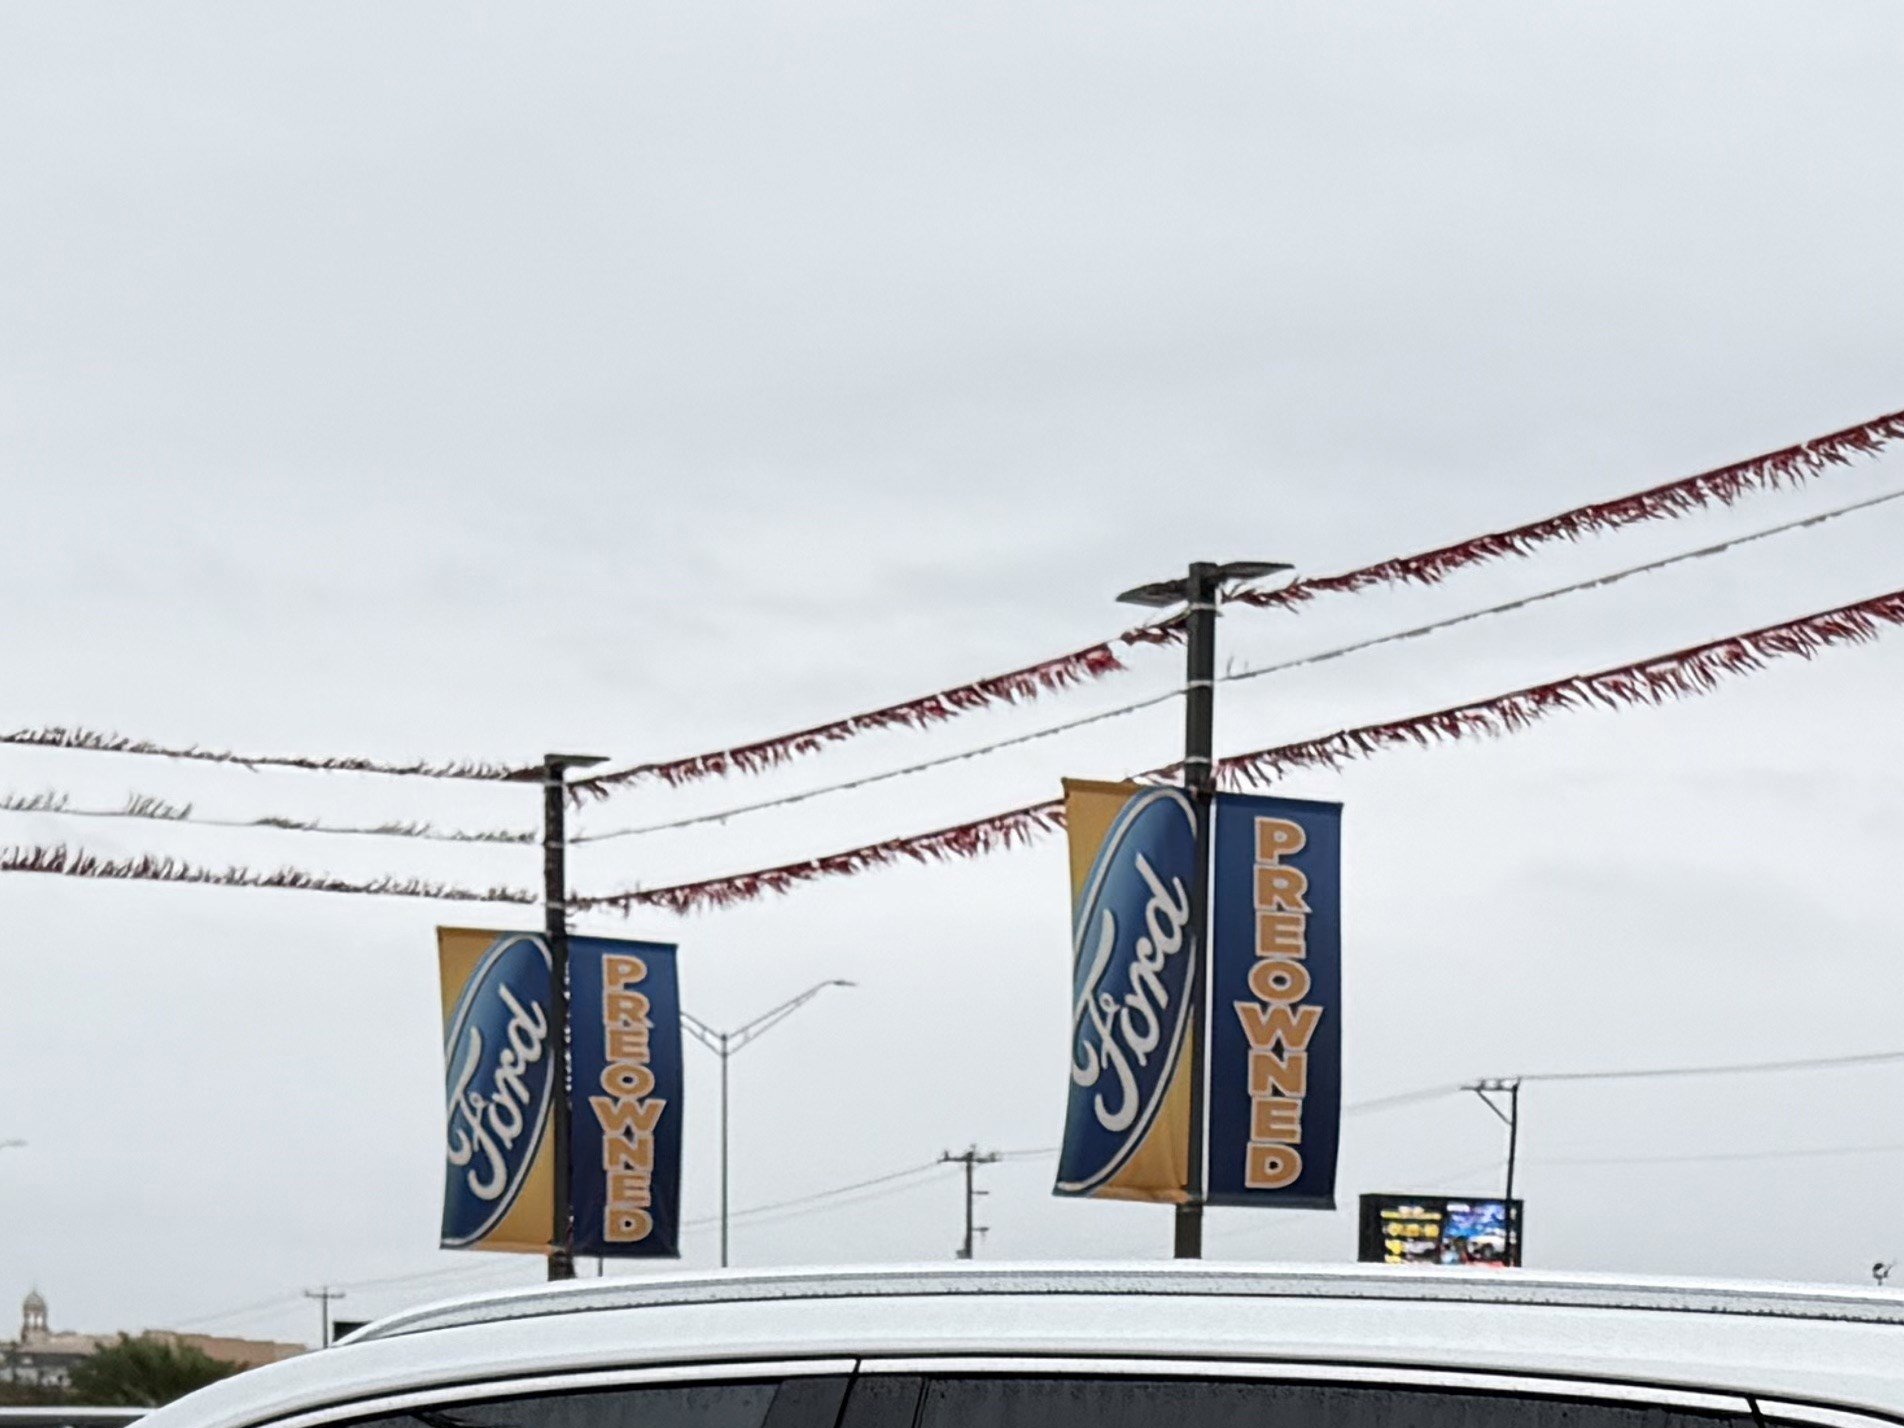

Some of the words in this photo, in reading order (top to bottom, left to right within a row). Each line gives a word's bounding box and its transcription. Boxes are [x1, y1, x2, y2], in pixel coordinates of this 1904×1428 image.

[447, 983, 548, 1200] Ford
[588, 954, 667, 1242] PREOWNED
[1072, 852, 1189, 1133] Ford
[1234, 816, 1323, 1189] PREOWNED
